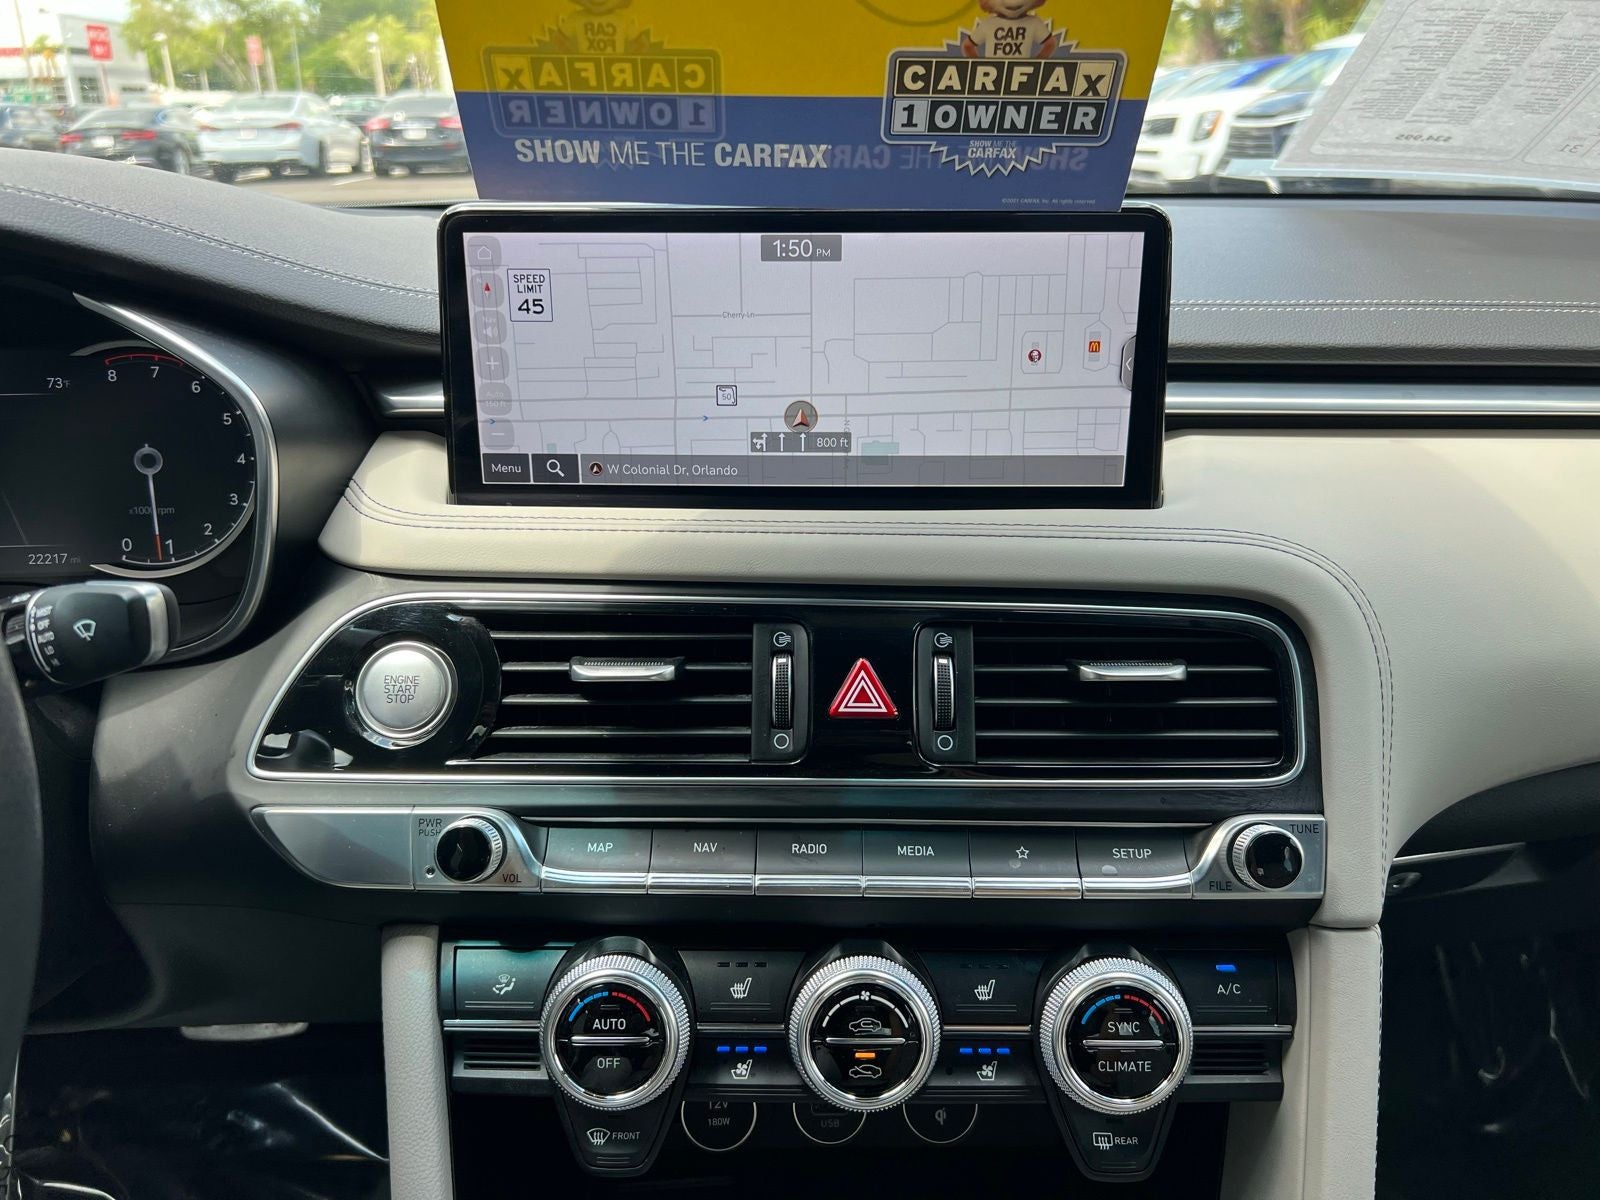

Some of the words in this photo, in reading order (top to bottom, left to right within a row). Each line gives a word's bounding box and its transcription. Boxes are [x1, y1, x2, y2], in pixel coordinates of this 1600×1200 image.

[994, 27, 1026, 41] CAR
[993, 43, 1023, 56] FOX
[903, 65, 1106, 97] CARFAX
[900, 104, 918, 128] 1
[934, 106, 1097, 130] OWNER
[970, 140, 992, 148] SHOW
[515, 139, 600, 164] SHOW
[610, 141, 649, 165] ME
[655, 141, 706, 166] THE
[715, 143, 828, 169] CARFAX
[968, 147, 1016, 159] CARFAX
[773, 239, 813, 258] 1:50
[816, 248, 831, 257] PM
[513, 274, 545, 284] SPEED
[517, 284, 543, 294] LIMIT
[517, 298, 544, 315] 45
[722, 311, 744, 319] Cherry
[107, 369, 118, 382] 8
[150, 366, 160, 378] 7
[191, 381, 201, 393] 6
[721, 393, 732, 401] 50
[223, 413, 232, 425] 5
[816, 437, 837, 448] 800
[839, 437, 849, 448] ft
[237, 453, 247, 466] 4
[491, 463, 522, 474] Menu
[607, 464, 619, 474] W
[622, 464, 670, 475] Colonial
[674, 465, 689, 477] Dr,
[692, 465, 738, 476] Orlando
[230, 494, 239, 505] 3
[204, 524, 213, 536] 2
[122, 538, 132, 551] 0
[165, 539, 173, 554] 1
[28, 553, 67, 565] 22217
[384, 675, 420, 684] ENGINE
[384, 685, 418, 694] START
[386, 694, 415, 704] STOP
[418, 819, 442, 828] PWR
[1290, 824, 1320, 834] TUNE
[418, 829, 441, 837] PUSH
[587, 843, 613, 853] MAP
[693, 842, 718, 853] NAV
[791, 844, 827, 855] RADIO
[897, 846, 934, 856] MEDIA
[1112, 848, 1152, 859] SETUP
[502, 874, 522, 883] VOL
[1209, 881, 1232, 891] FILE
[1216, 983, 1241, 995] A/C
[593, 1018, 626, 1031] AUTO
[1107, 1021, 1140, 1033] SYNC
[597, 1057, 621, 1069] OFF
[1098, 1060, 1152, 1072] CLIMATE
[708, 1117, 730, 1126] 180W
[820, 1119, 841, 1128] USB
[612, 1131, 641, 1140] FRONT
[1114, 1136, 1139, 1145] REAR
